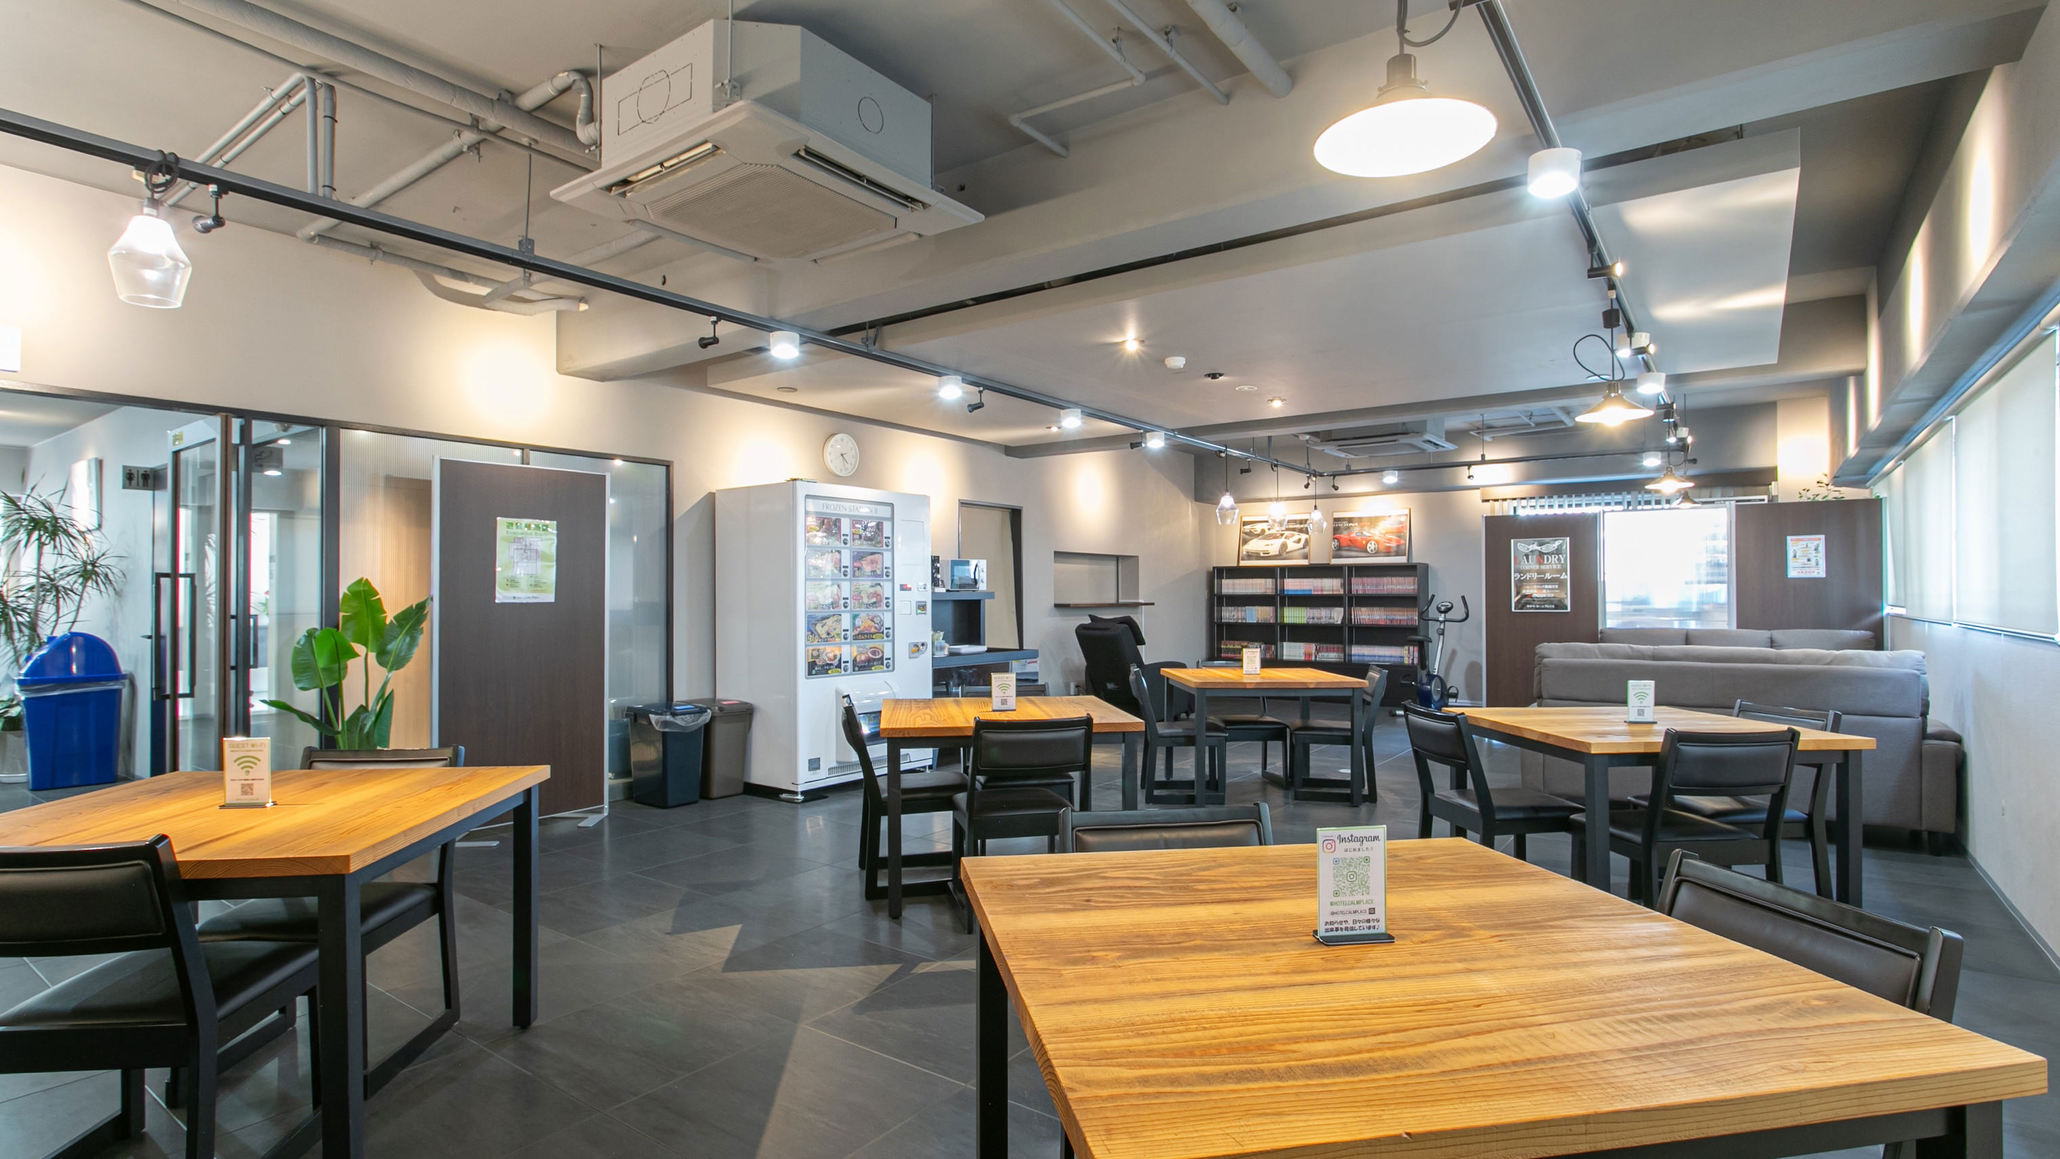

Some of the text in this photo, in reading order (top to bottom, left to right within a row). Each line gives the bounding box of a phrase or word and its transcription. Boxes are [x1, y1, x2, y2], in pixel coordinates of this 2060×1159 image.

[1514, 572, 1568, 580] ランドリールーム
[1337, 834, 1380, 846] Instagram
